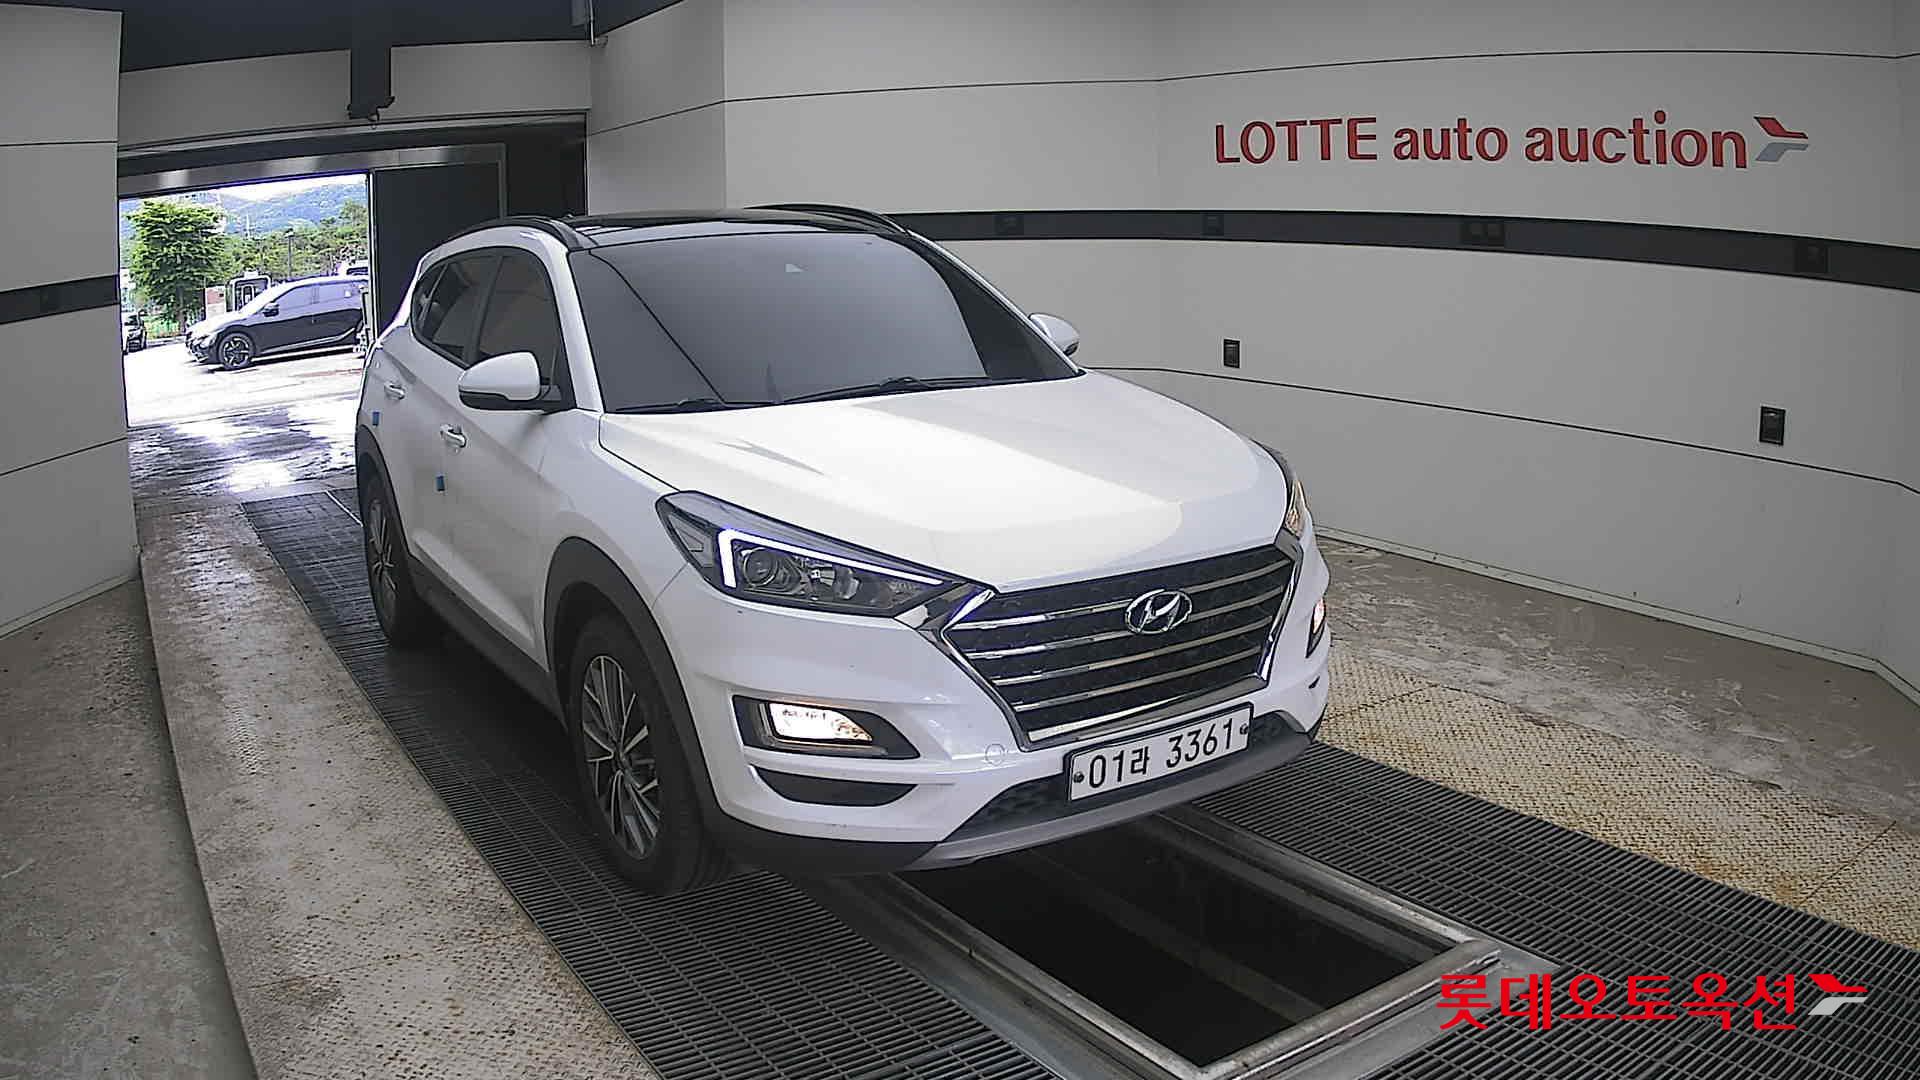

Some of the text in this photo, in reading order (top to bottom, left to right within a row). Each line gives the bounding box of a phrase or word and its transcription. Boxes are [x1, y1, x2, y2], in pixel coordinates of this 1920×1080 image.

[1215, 110, 1748, 169] LOTTE auto auction
[1088, 717, 1234, 789] 01라 3361
